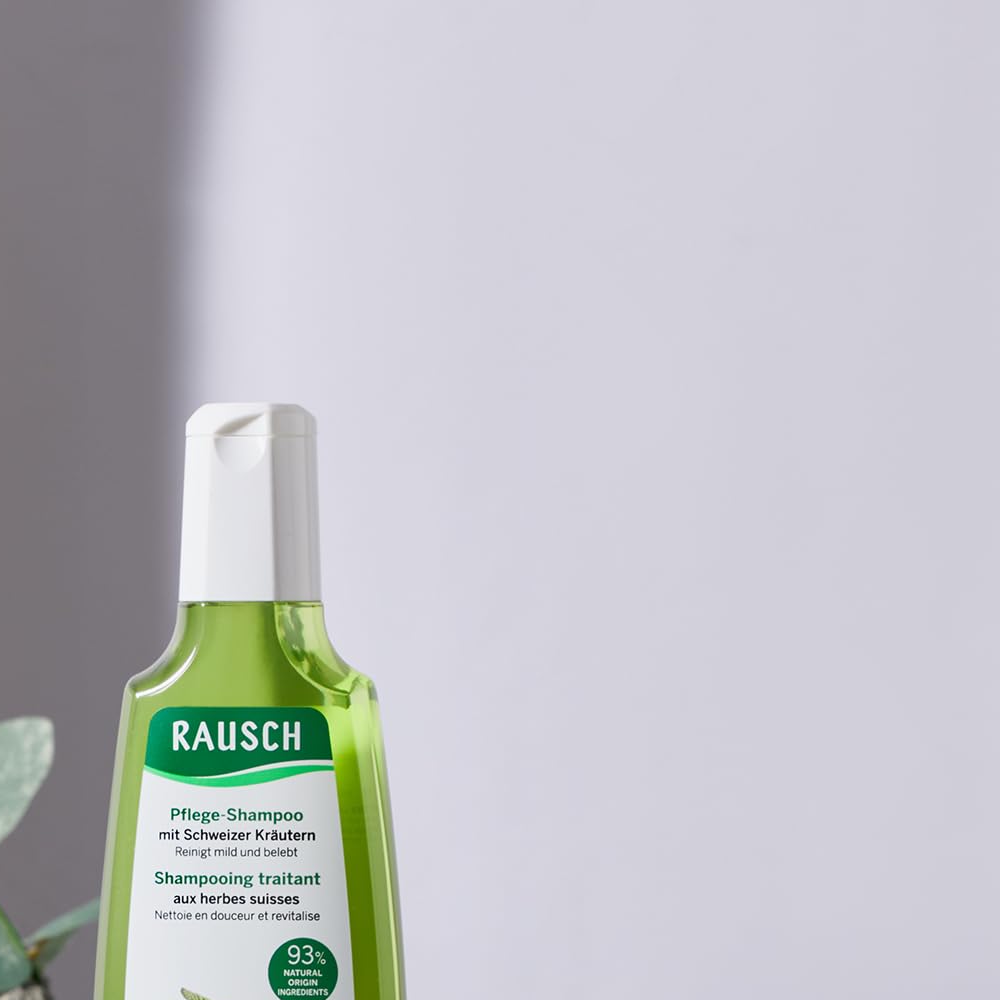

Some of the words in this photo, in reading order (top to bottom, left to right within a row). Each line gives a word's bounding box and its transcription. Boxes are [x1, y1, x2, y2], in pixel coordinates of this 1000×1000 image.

[172, 720, 301, 752] RAUSCH
[170, 808, 304, 824] Pflege-Shampoo
[158, 829, 180, 841] mit
[183, 829, 252, 841] Schweizer
[255, 829, 316, 841] Kräutern
[175, 847, 211, 859] Reinigt
[214, 847, 238, 858] mild
[240, 847, 261, 858] und
[263, 847, 298, 858] belebt
[154, 872, 254, 888] Shampooing
[259, 872, 321, 886] traitant
[173, 895, 197, 905] aux
[200, 893, 246, 905] herbes
[249, 894, 300, 905] suisses
[154, 910, 193, 921] Nettoie
[195, 913, 208, 921] en
[211, 911, 255, 921] douceur
[257, 912, 268, 921] et
[271, 911, 321, 922] revitalise
[287, 944, 327, 965] 93%
[283, 969, 323, 977] NATURAL
[288, 978, 319, 986] ORIGIN
[277, 988, 329, 996] INGREDIENTS
